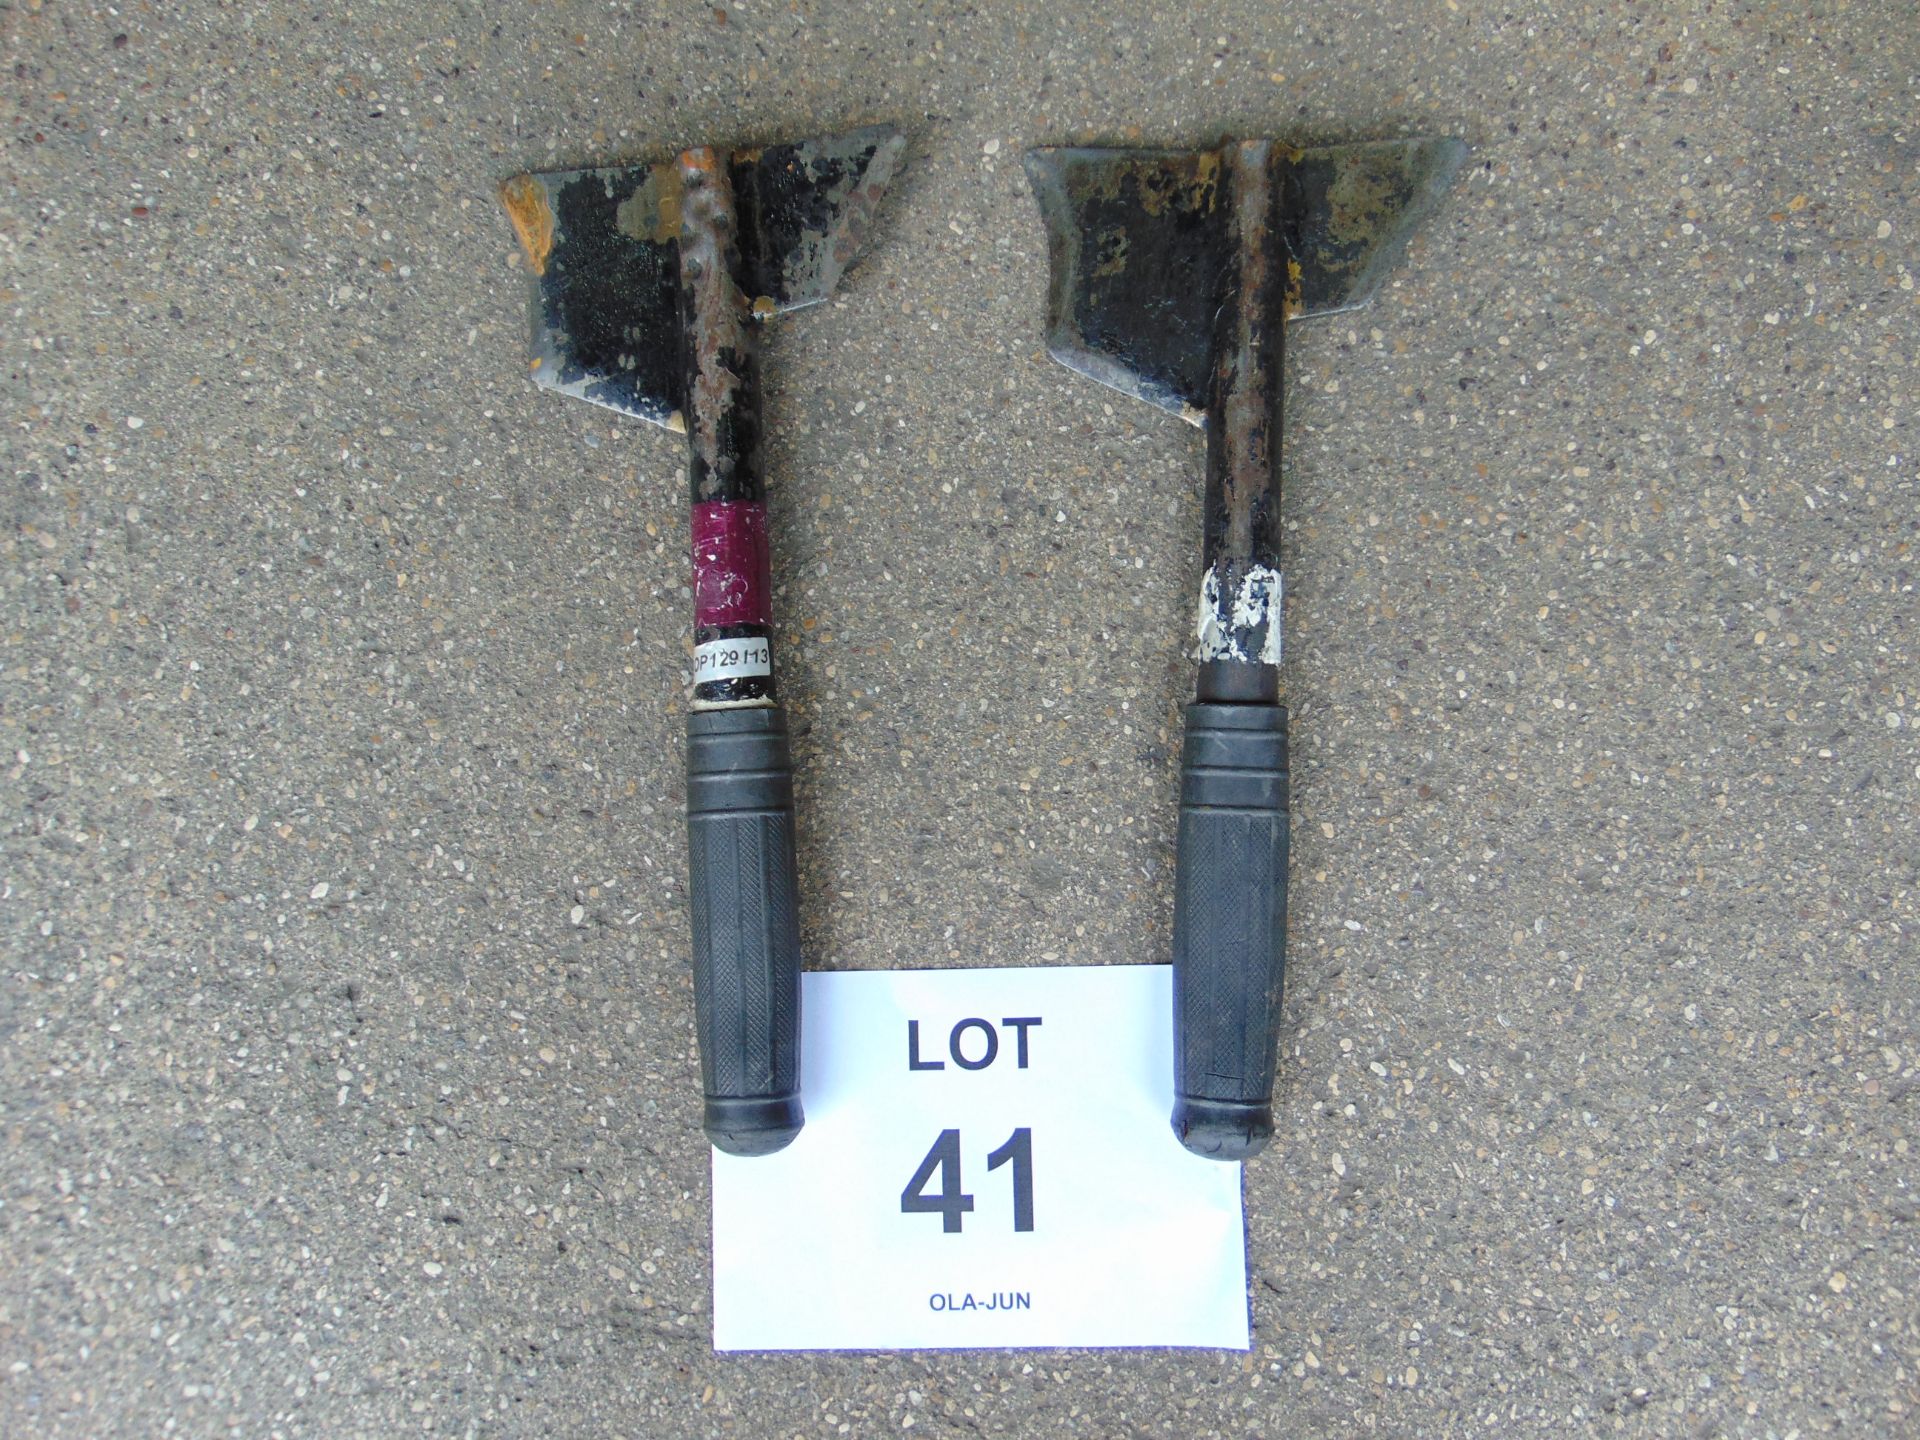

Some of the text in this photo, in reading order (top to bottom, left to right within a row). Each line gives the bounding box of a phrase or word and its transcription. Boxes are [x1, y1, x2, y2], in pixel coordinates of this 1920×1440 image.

[908, 1017, 1042, 1071] LOT
[901, 1127, 1034, 1233] 41
[929, 1292, 1031, 1312] OLA-JUN
